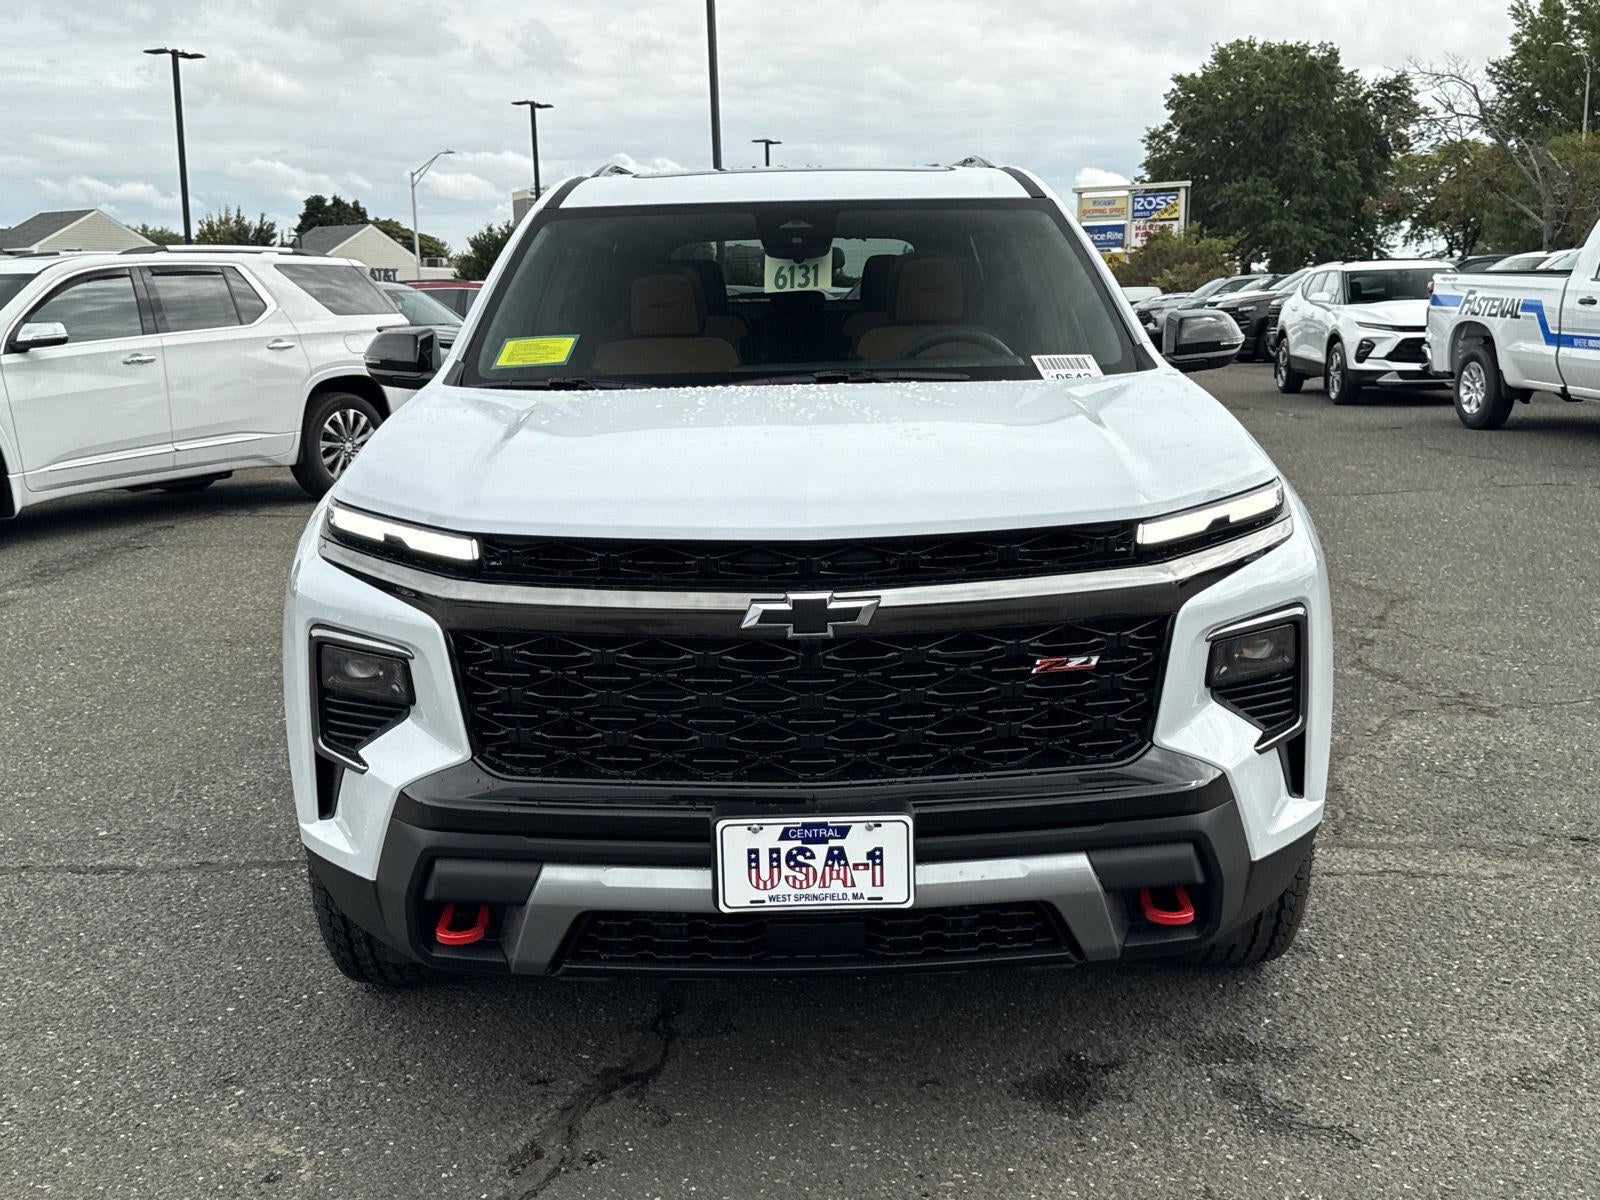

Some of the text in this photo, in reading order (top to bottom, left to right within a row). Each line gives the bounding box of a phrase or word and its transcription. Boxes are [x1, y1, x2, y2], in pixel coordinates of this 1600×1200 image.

[1106, 231, 1124, 240] Rite
[369, 267, 399, 282] AT&T
[773, 263, 819, 290] 6131
[788, 828, 841, 839] CENTRAL
[746, 845, 885, 891] USA-1
[768, 892, 865, 903] WEST SPRINGFIELD, MA
